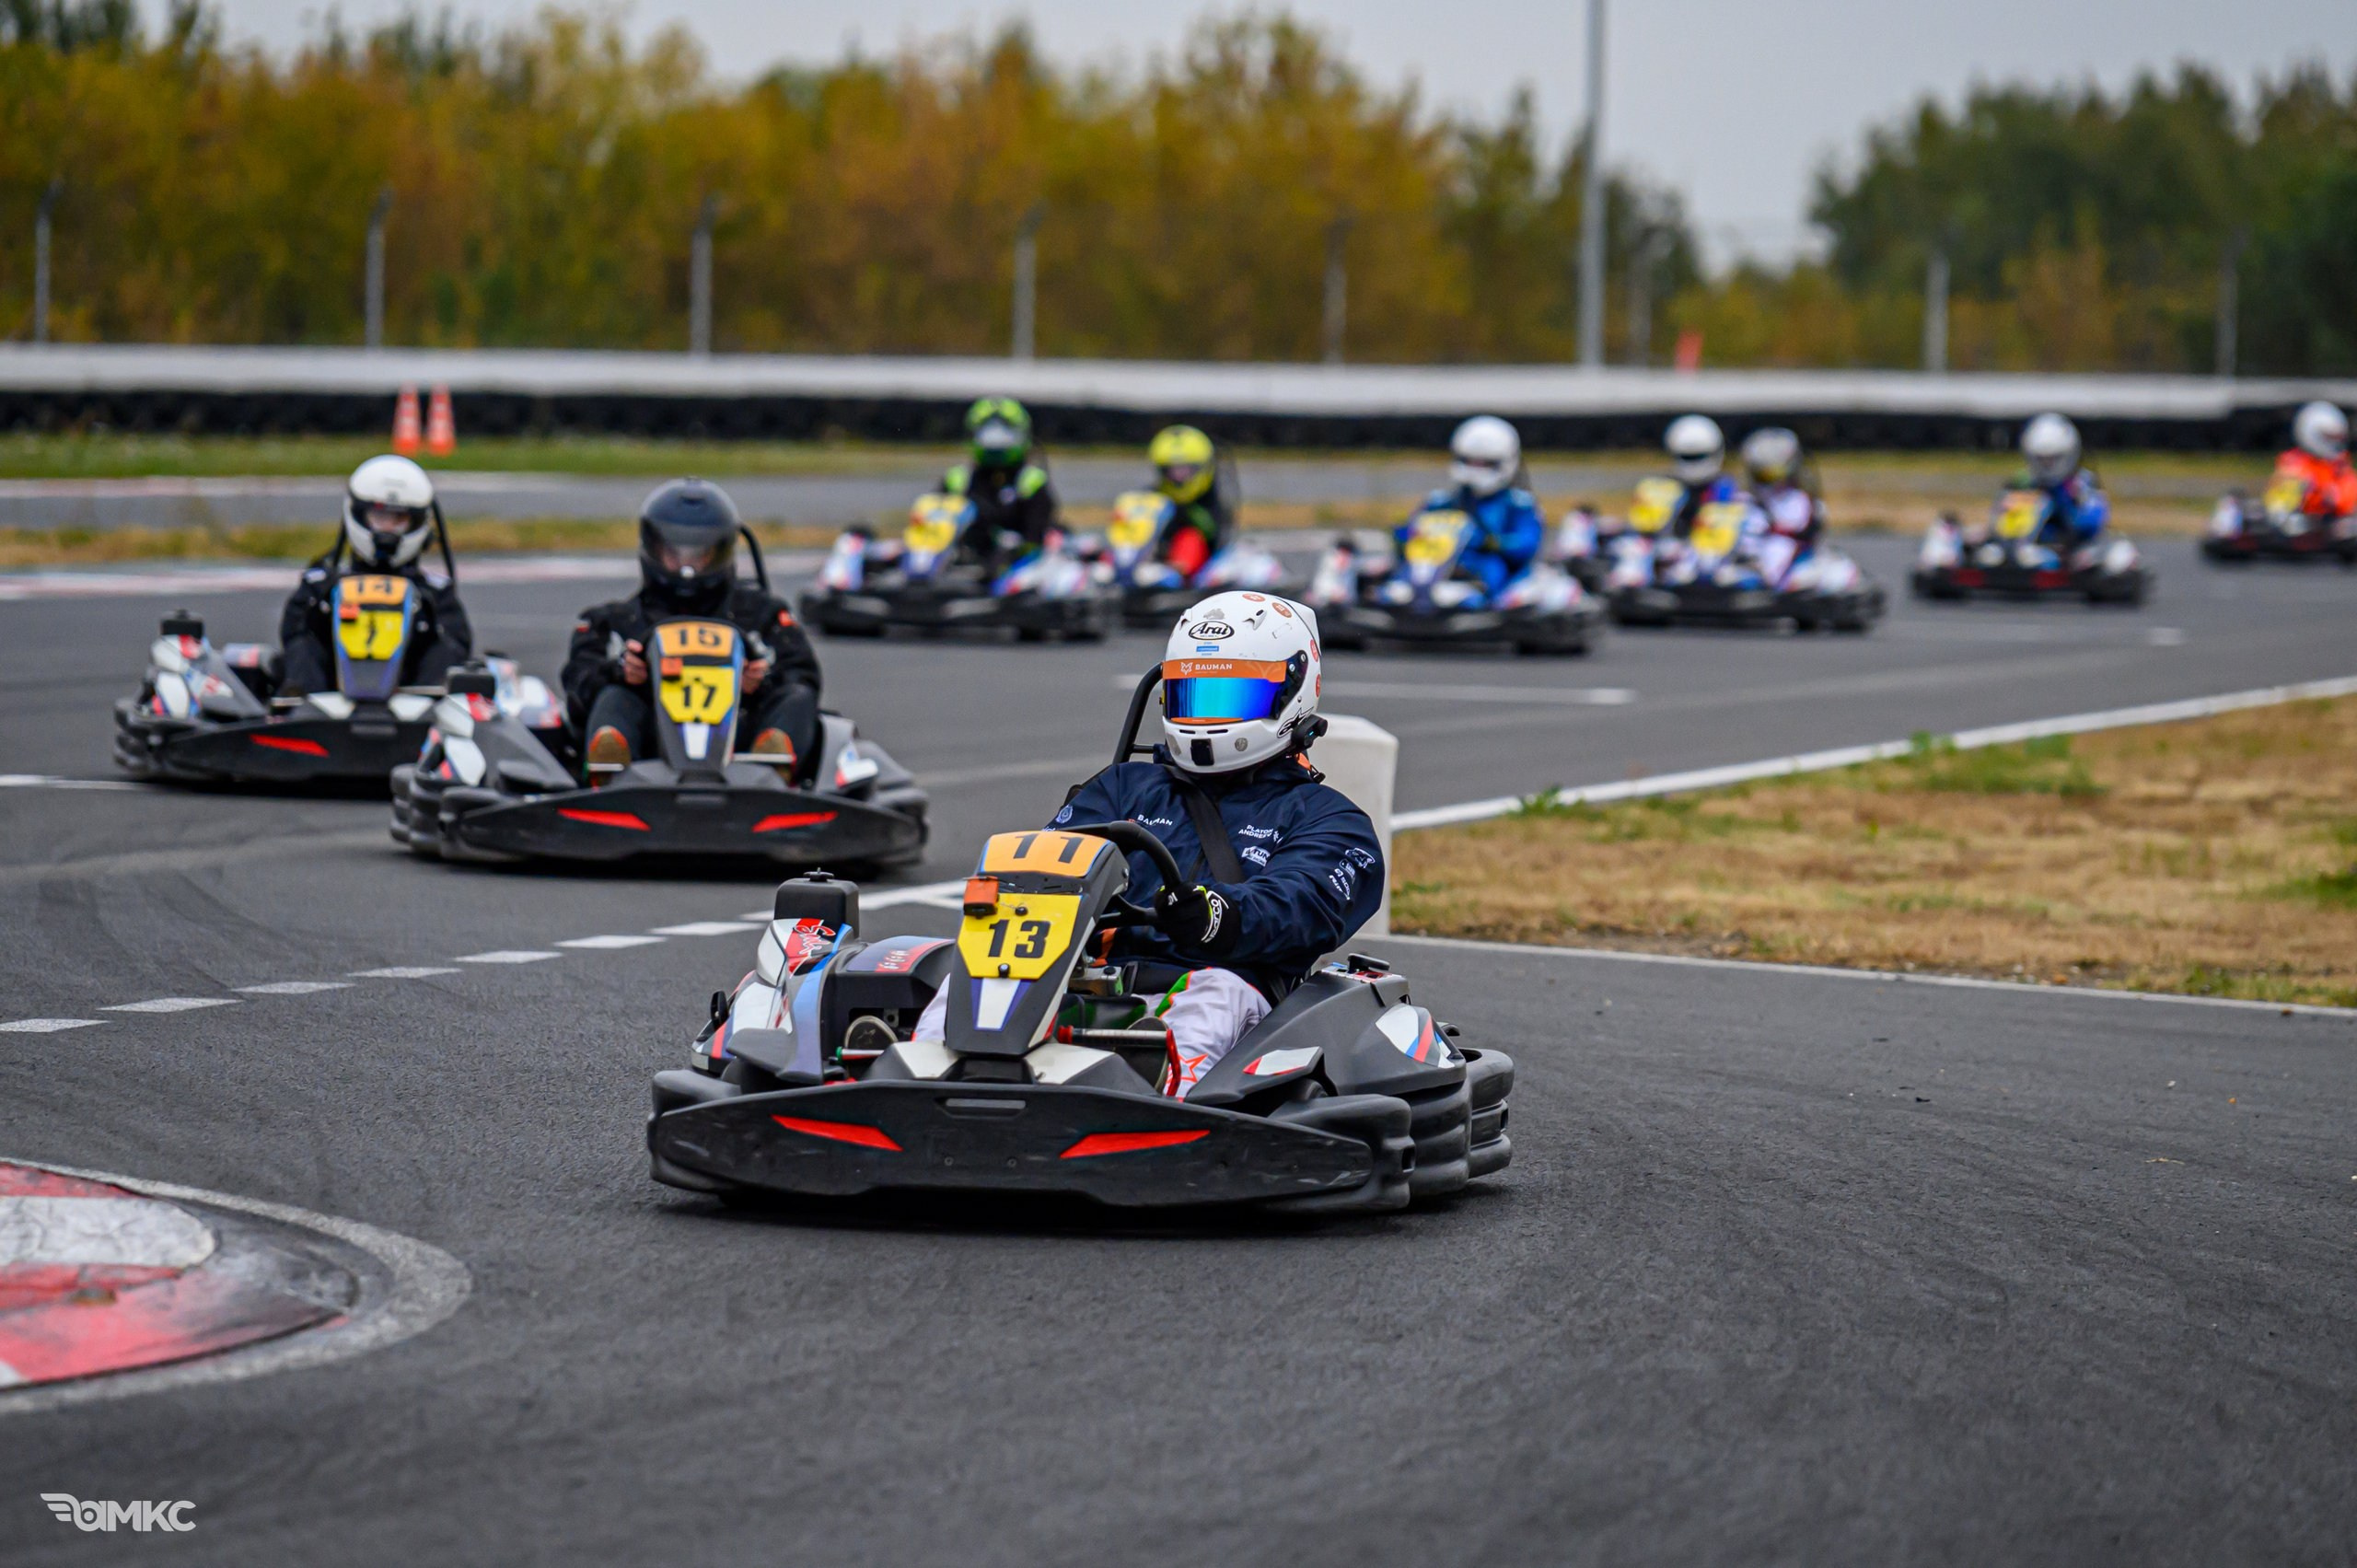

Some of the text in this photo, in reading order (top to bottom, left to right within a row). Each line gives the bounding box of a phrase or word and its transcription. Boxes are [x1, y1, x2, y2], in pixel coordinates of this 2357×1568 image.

[679, 628, 722, 646] 15
[1190, 622, 1229, 635] Arai
[1194, 663, 1233, 671] BAUMAN
[682, 684, 718, 708] 17
[1013, 833, 1085, 864] 11
[987, 919, 1051, 958] 13
